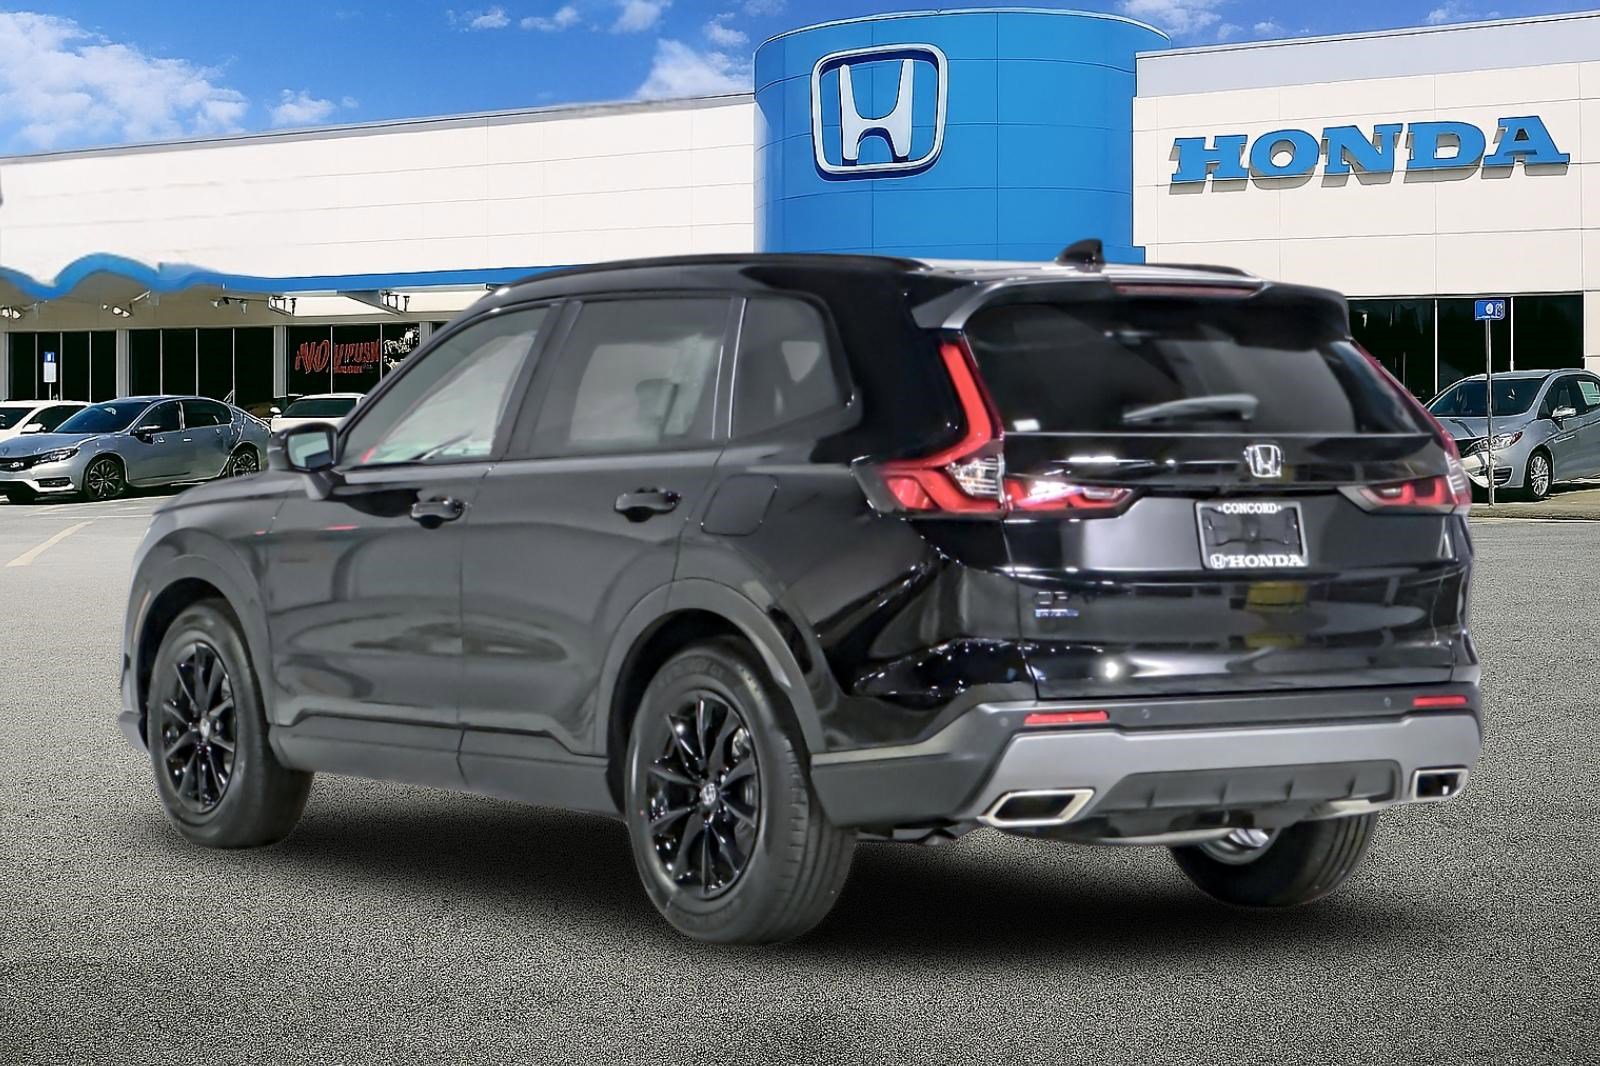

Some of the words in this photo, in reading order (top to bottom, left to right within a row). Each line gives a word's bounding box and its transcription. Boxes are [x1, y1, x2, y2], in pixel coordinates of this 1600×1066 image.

[1171, 115, 1570, 182] HONDA
[1222, 503, 1278, 514] CONCORD
[1227, 554, 1304, 568] HONDA
